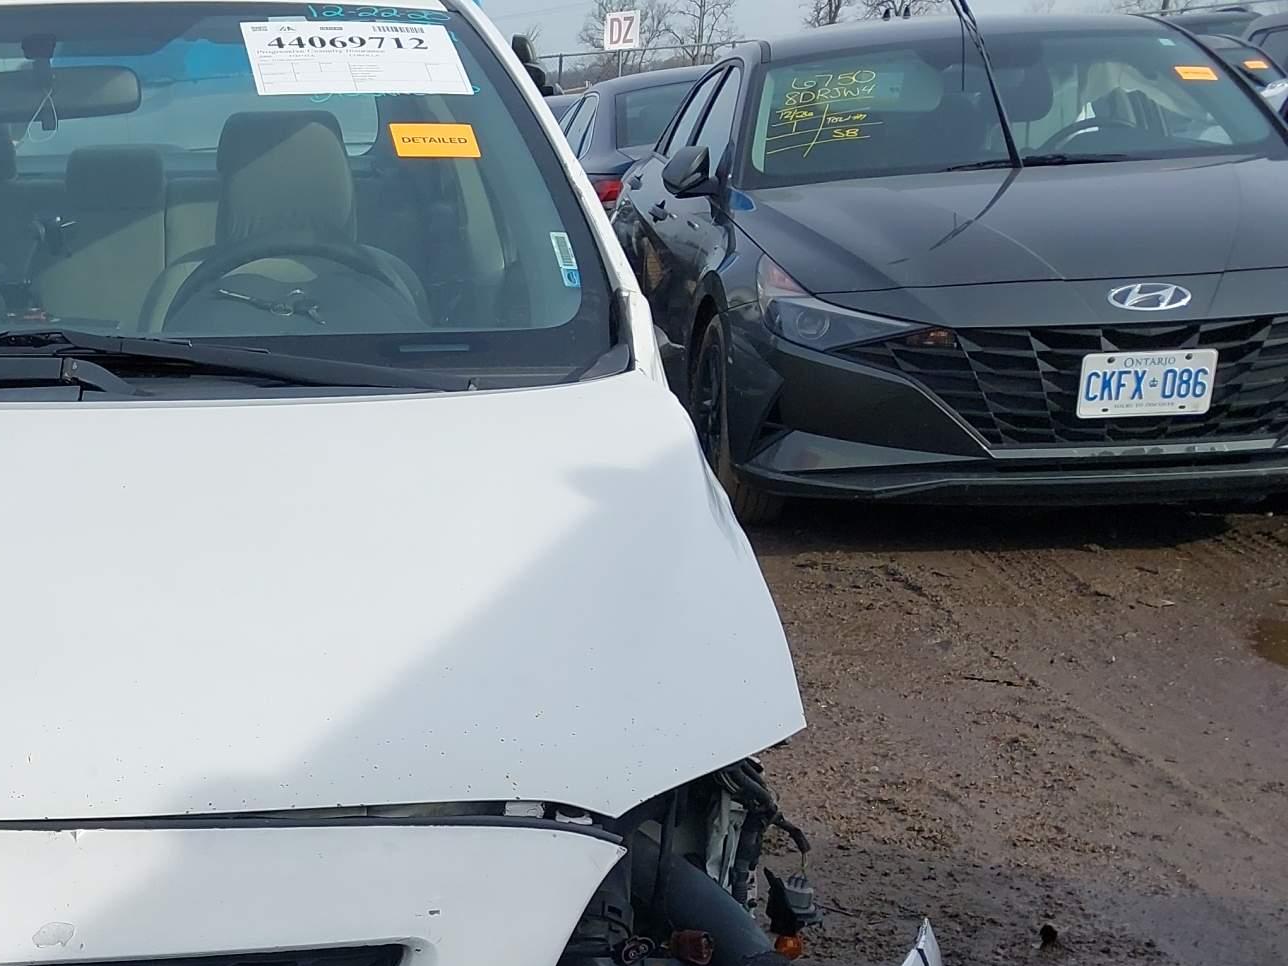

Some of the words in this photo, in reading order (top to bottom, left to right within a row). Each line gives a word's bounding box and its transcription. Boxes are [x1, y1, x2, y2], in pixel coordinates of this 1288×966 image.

[610, 16, 634, 44] DZ
[267, 36, 429, 50] 44069712
[792, 70, 876, 89] 6750
[785, 84, 876, 106] 8DRJW4
[401, 136, 468, 144] DETAILED
[1124, 356, 1176, 368] ONTARIO
[1085, 369, 1147, 401] CKFX
[1161, 368, 1209, 399] 086
